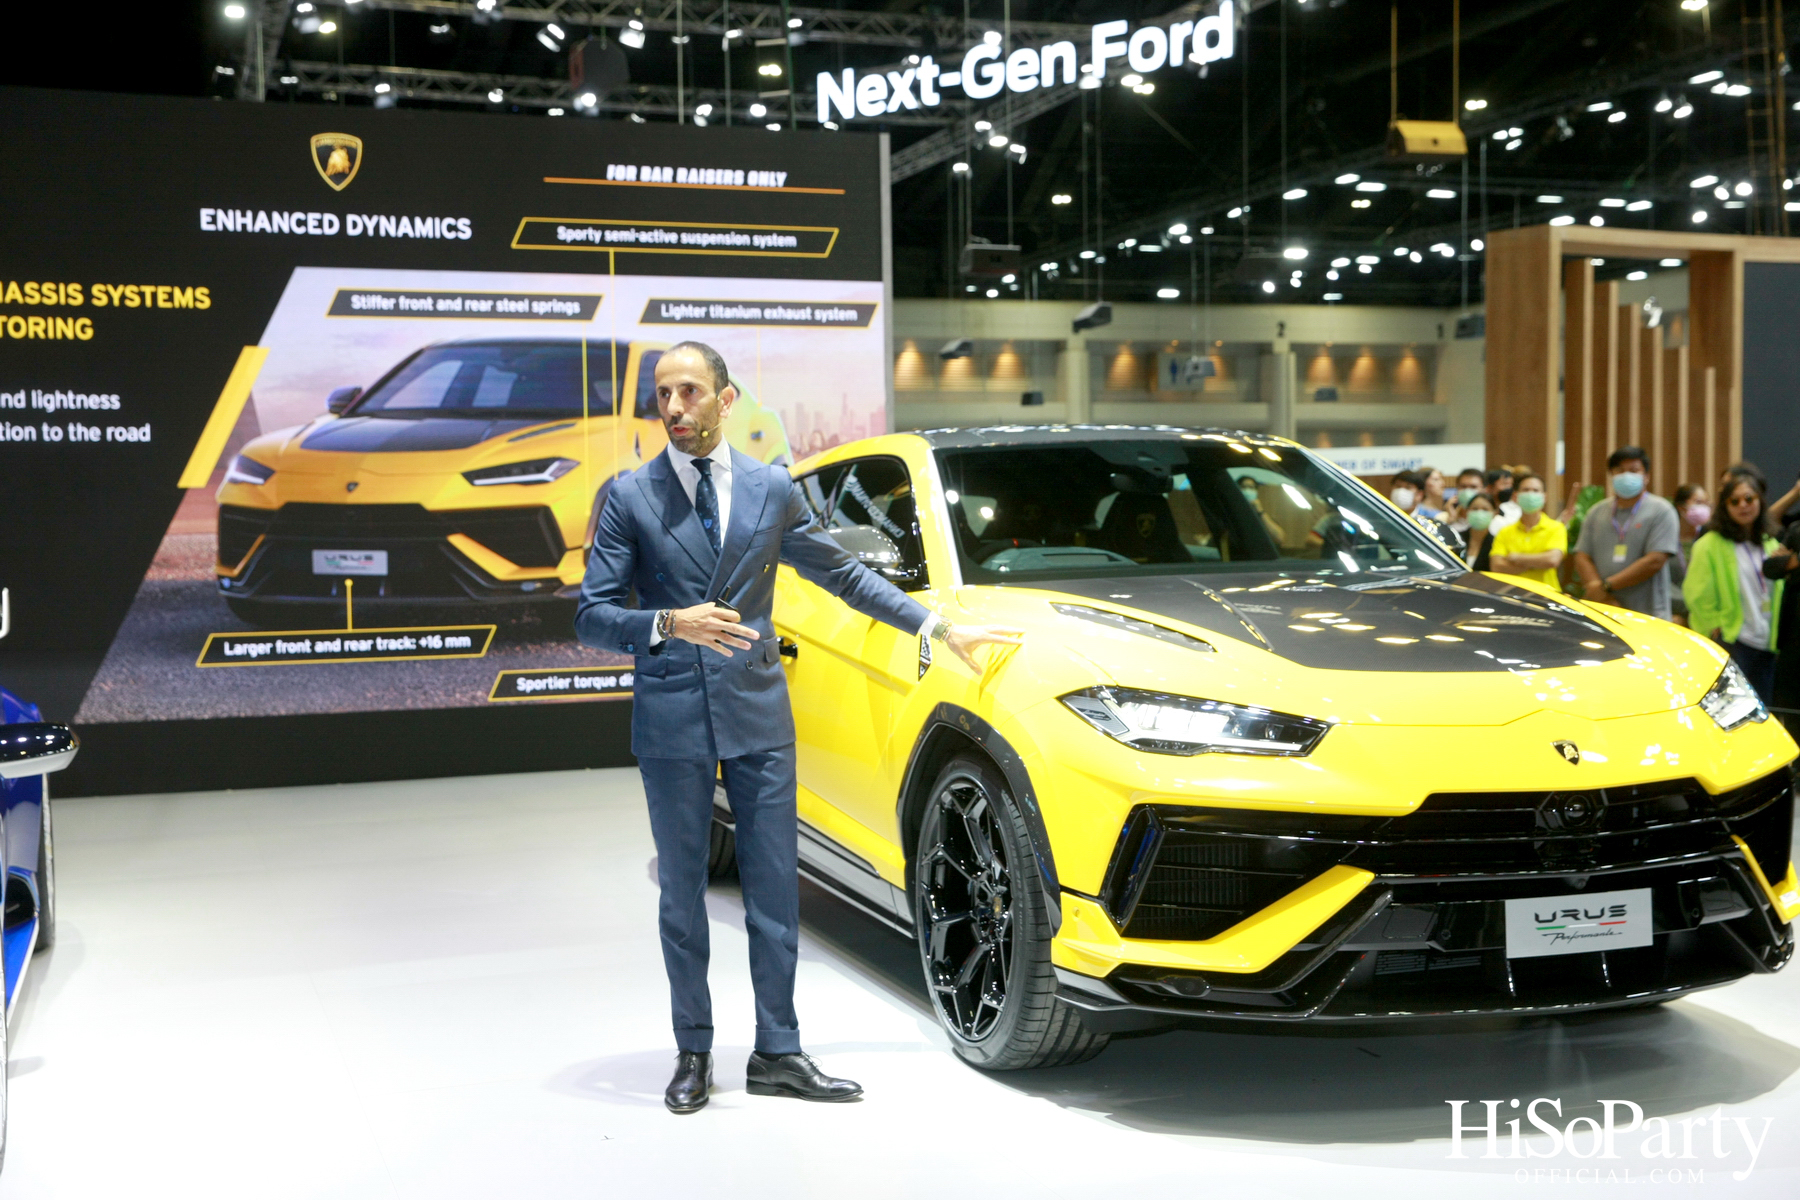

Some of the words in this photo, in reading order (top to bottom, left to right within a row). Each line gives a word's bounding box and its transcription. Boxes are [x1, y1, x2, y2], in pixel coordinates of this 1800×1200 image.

[816, 40, 1077, 123] Next-Gen
[1091, 0, 1234, 79] Ford
[606, 163, 638, 182] FOR
[639, 165, 674, 184] BAR
[675, 167, 745, 187] RAISERS
[747, 170, 788, 188] ONLY
[199, 207, 341, 236] ENHANCED
[346, 213, 473, 241] DYNAMICS
[556, 224, 603, 245] Sporty
[603, 226, 679, 244] semi-active
[679, 230, 751, 249] suspension
[751, 232, 798, 250] system
[0, 281, 85, 307] ASSIS
[91, 283, 212, 310] SYSTEMS
[350, 294, 397, 311] Stiffer
[397, 295, 434, 312] front
[435, 296, 463, 312] and
[463, 299, 494, 313] rear
[495, 298, 529, 314] steel
[530, 299, 582, 317] springs
[659, 302, 708, 321] Lighter
[708, 303, 762, 320] titanium
[762, 306, 813, 321] exhaust
[813, 307, 859, 324] system
[0, 388, 26, 409] nd
[31, 389, 121, 413] lightness
[41, 422, 64, 442] to
[67, 422, 102, 442] the
[106, 423, 152, 443] road
[223, 640, 274, 658] Larger
[275, 639, 313, 654] front
[314, 638, 342, 653] and
[343, 638, 375, 652] rear
[375, 636, 417, 651] track:
[418, 635, 443, 649] +16
[444, 636, 472, 648] mm
[516, 676, 573, 694] Sportier
[573, 675, 618, 691] torque
[1534, 904, 1628, 924] URUS
